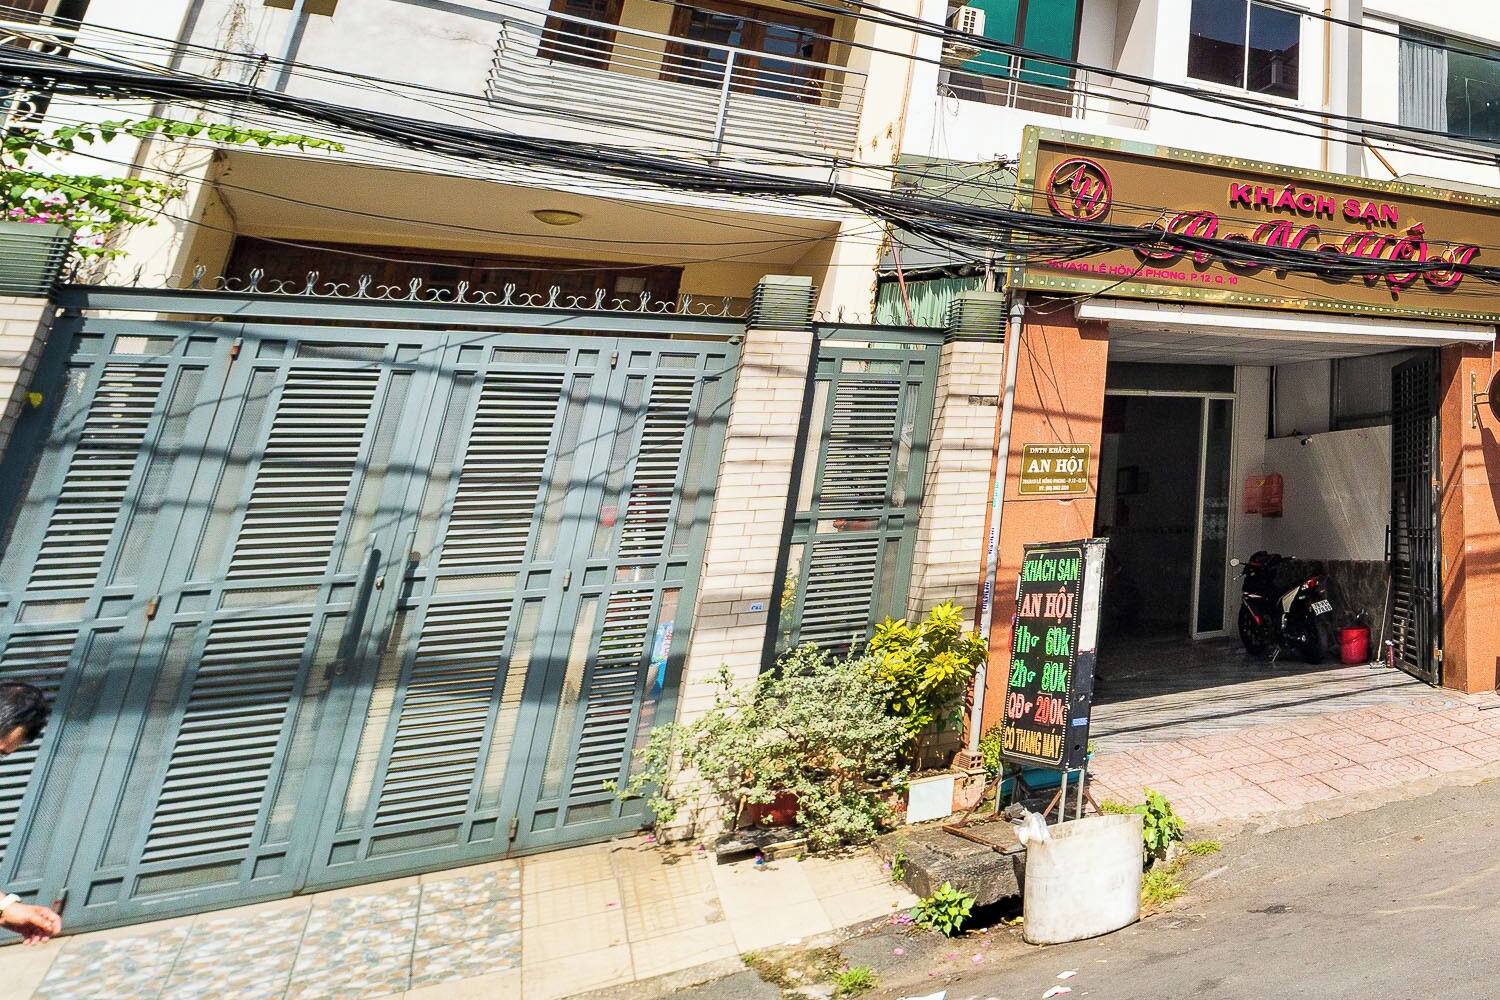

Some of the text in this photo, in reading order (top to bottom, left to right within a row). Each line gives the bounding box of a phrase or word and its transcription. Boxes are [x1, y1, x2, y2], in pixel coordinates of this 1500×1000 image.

[1231, 183, 1399, 224] KHÁCH SẠN
[1092, 262, 1106, 273] LÊ
[1229, 276, 1238, 285] 10
[1028, 455, 1084, 475] AN HỘI
[1048, 446, 1071, 454] KHÁCH
[1023, 554, 1079, 585] KHÁCH SẠN
[1019, 593, 1043, 617] AN
[1044, 586, 1074, 624] HỘI
[1017, 625, 1071, 656] 1h 60k
[1009, 659, 1068, 692] 2h 80k
[1008, 692, 1065, 725] QĐ 200k
[1004, 721, 1061, 758] CÓ THANG MÁY
